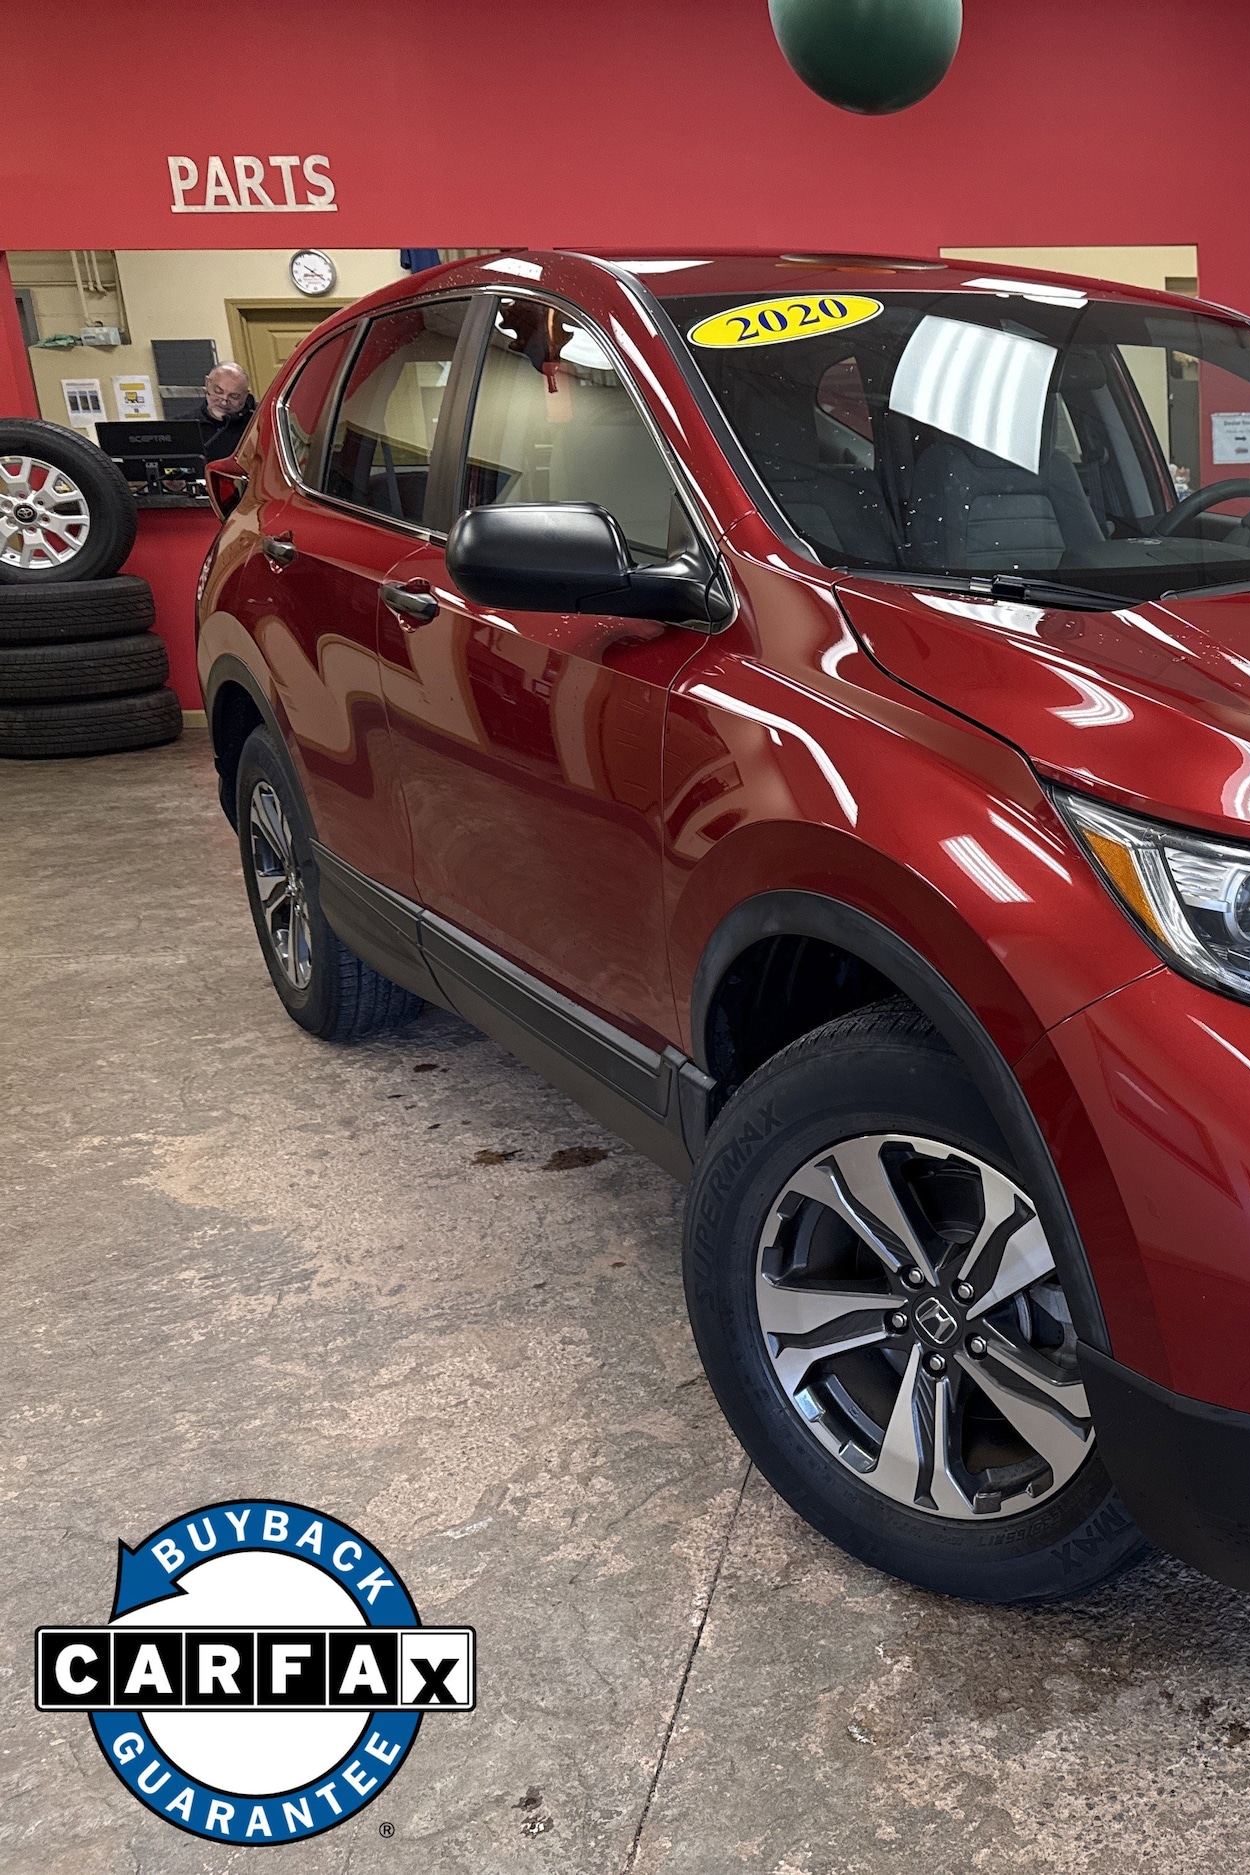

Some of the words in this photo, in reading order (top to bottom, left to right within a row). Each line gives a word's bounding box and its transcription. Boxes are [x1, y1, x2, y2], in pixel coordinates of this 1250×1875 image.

[167, 154, 337, 211] PARTS
[725, 298, 849, 342] 2020
[128, 434, 172, 443] SCEPTRE
[693, 1098, 785, 1313] SUPERMAX
